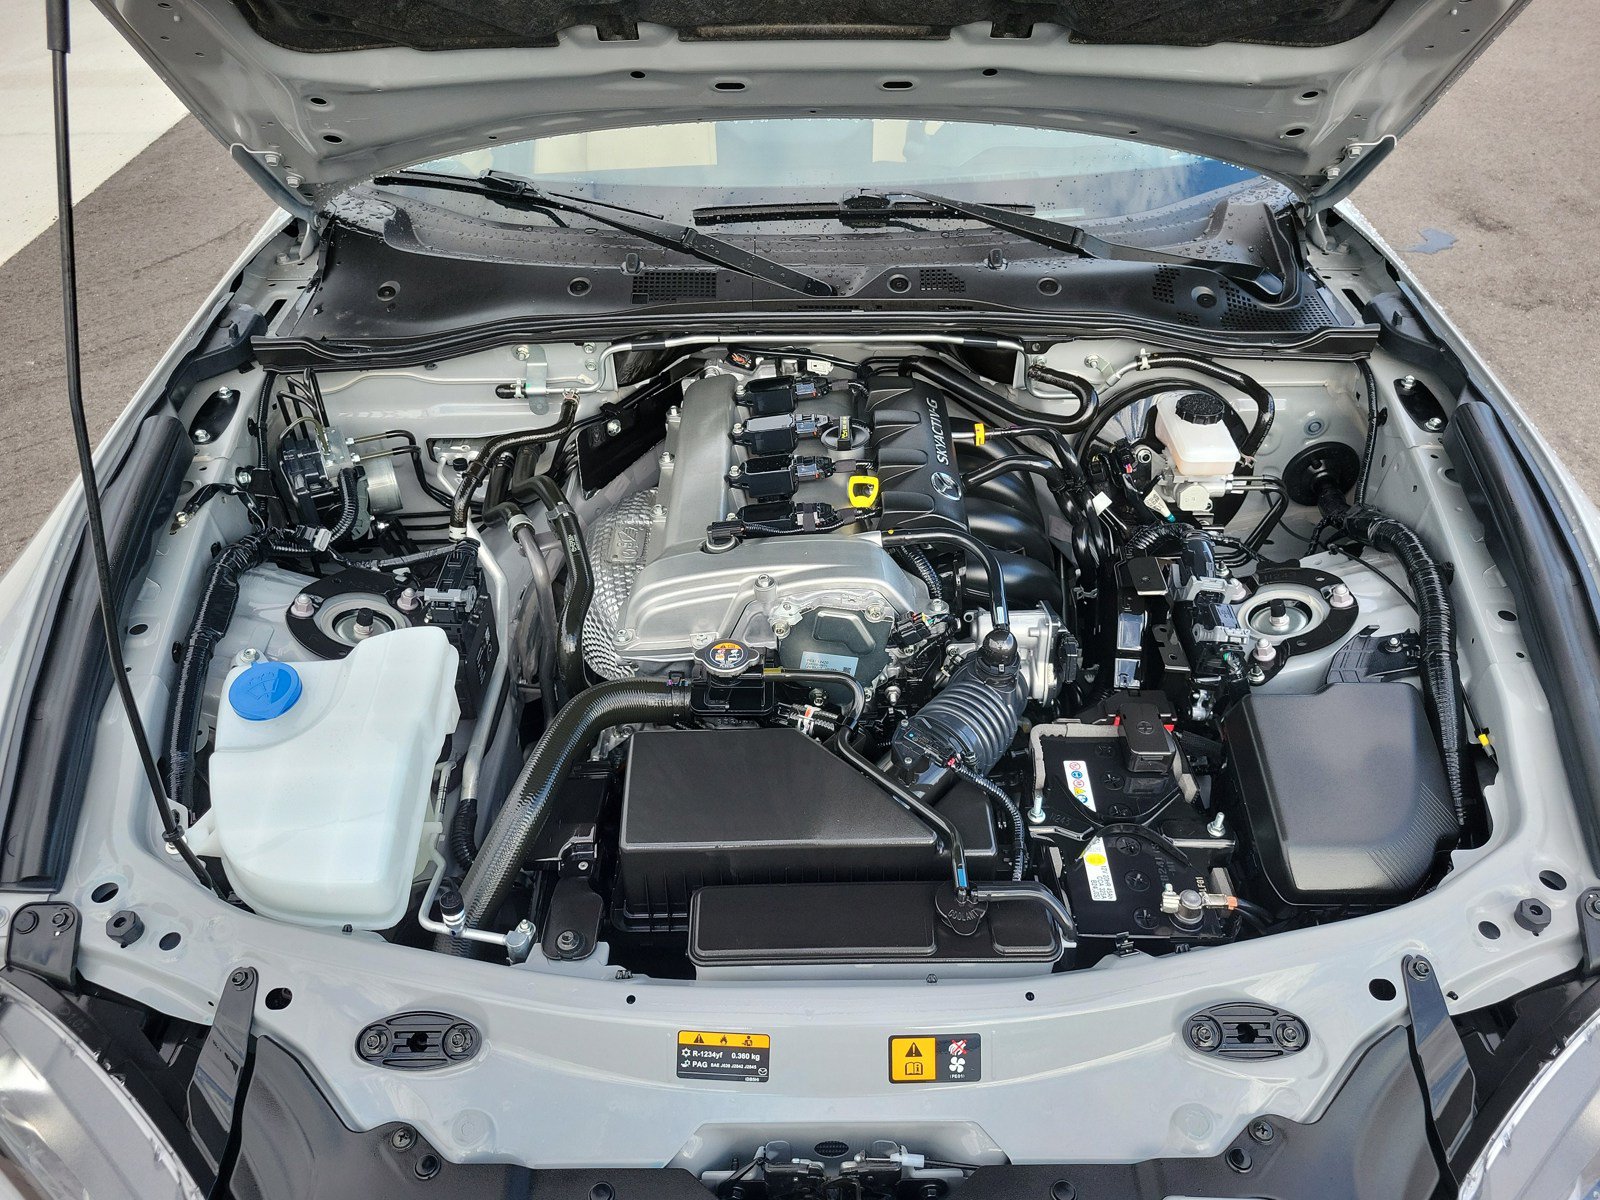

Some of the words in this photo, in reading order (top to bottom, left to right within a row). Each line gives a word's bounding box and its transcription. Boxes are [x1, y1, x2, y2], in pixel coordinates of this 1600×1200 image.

[926, 397, 949, 465] SKYACTIV-G
[948, 909, 979, 921] COOLANT
[692, 1050, 723, 1059] R-1234yf
[751, 1053, 760, 1061] kg
[692, 1060, 708, 1068] PAG
